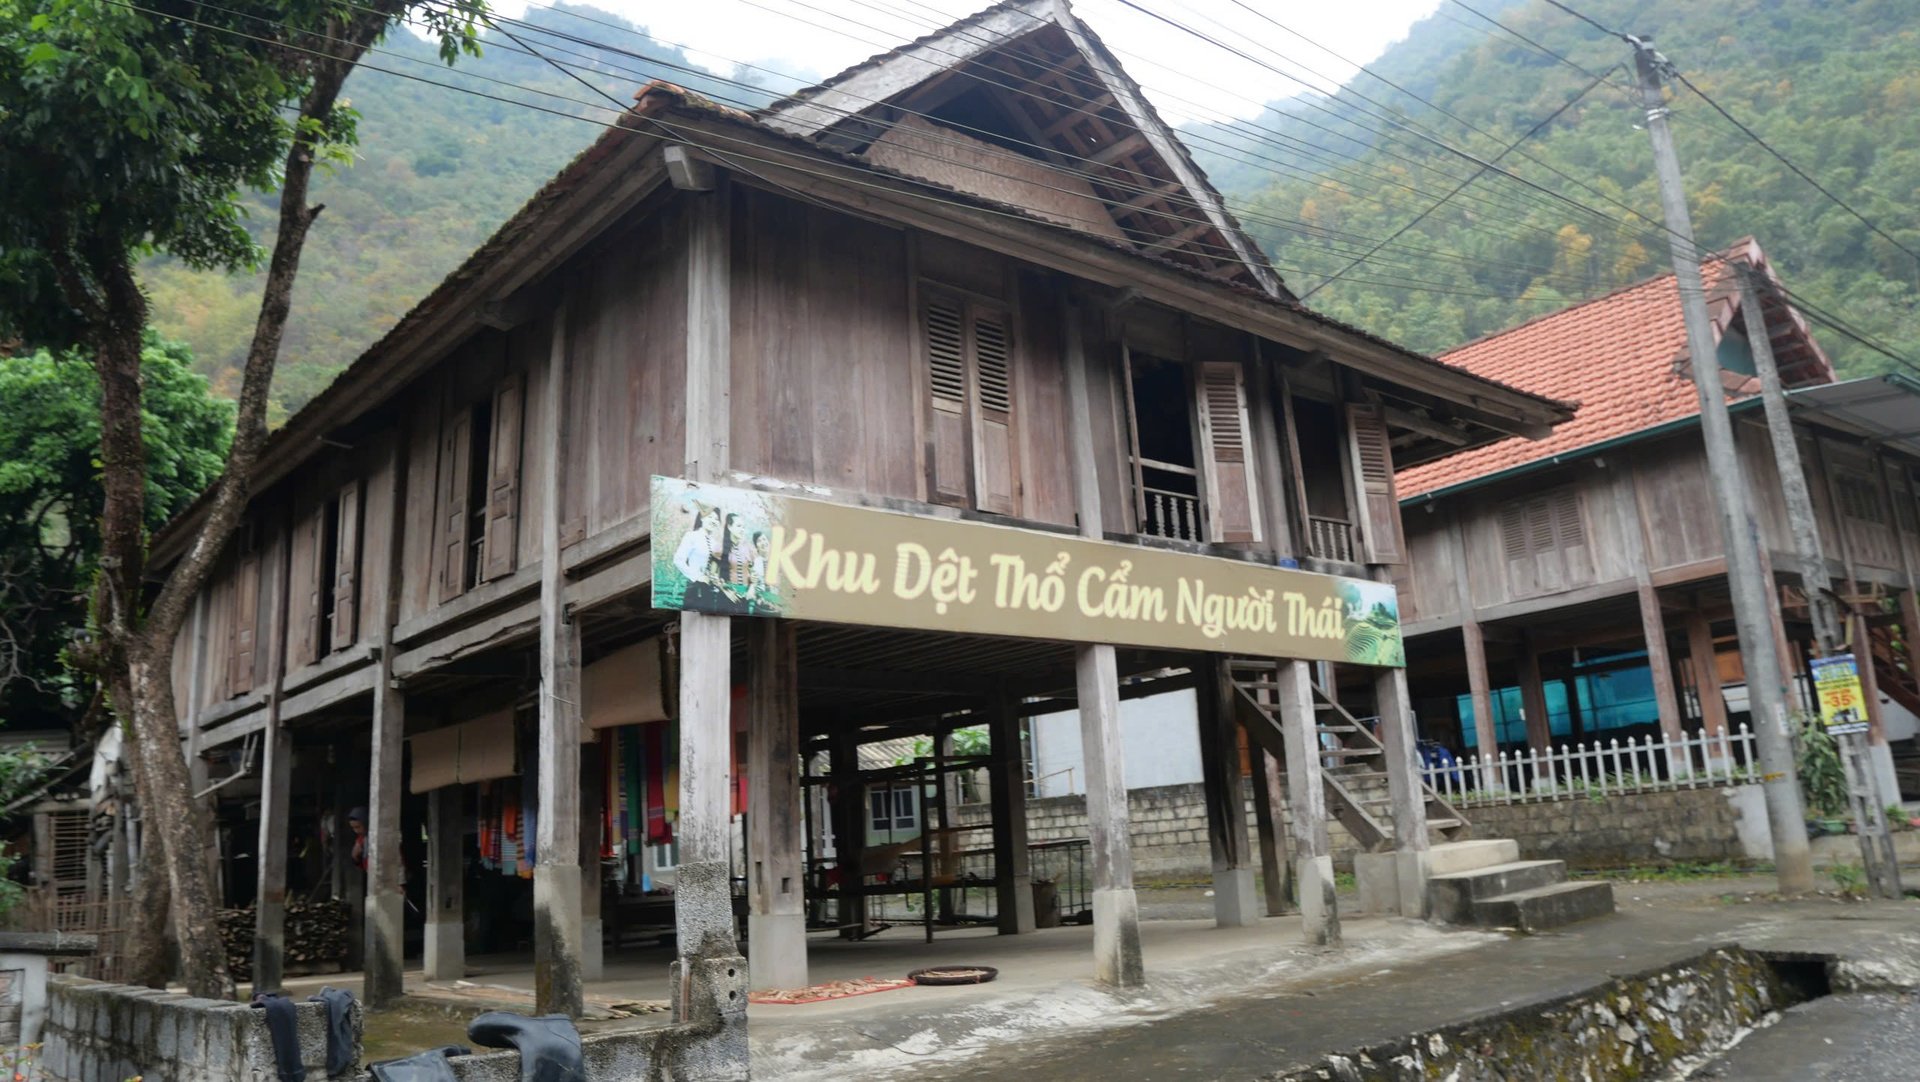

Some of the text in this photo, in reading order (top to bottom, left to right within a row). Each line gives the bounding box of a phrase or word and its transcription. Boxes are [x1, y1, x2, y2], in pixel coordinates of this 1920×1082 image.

[767, 525, 1346, 640] Khu Dệt Thổ Cẩm Người Thái
